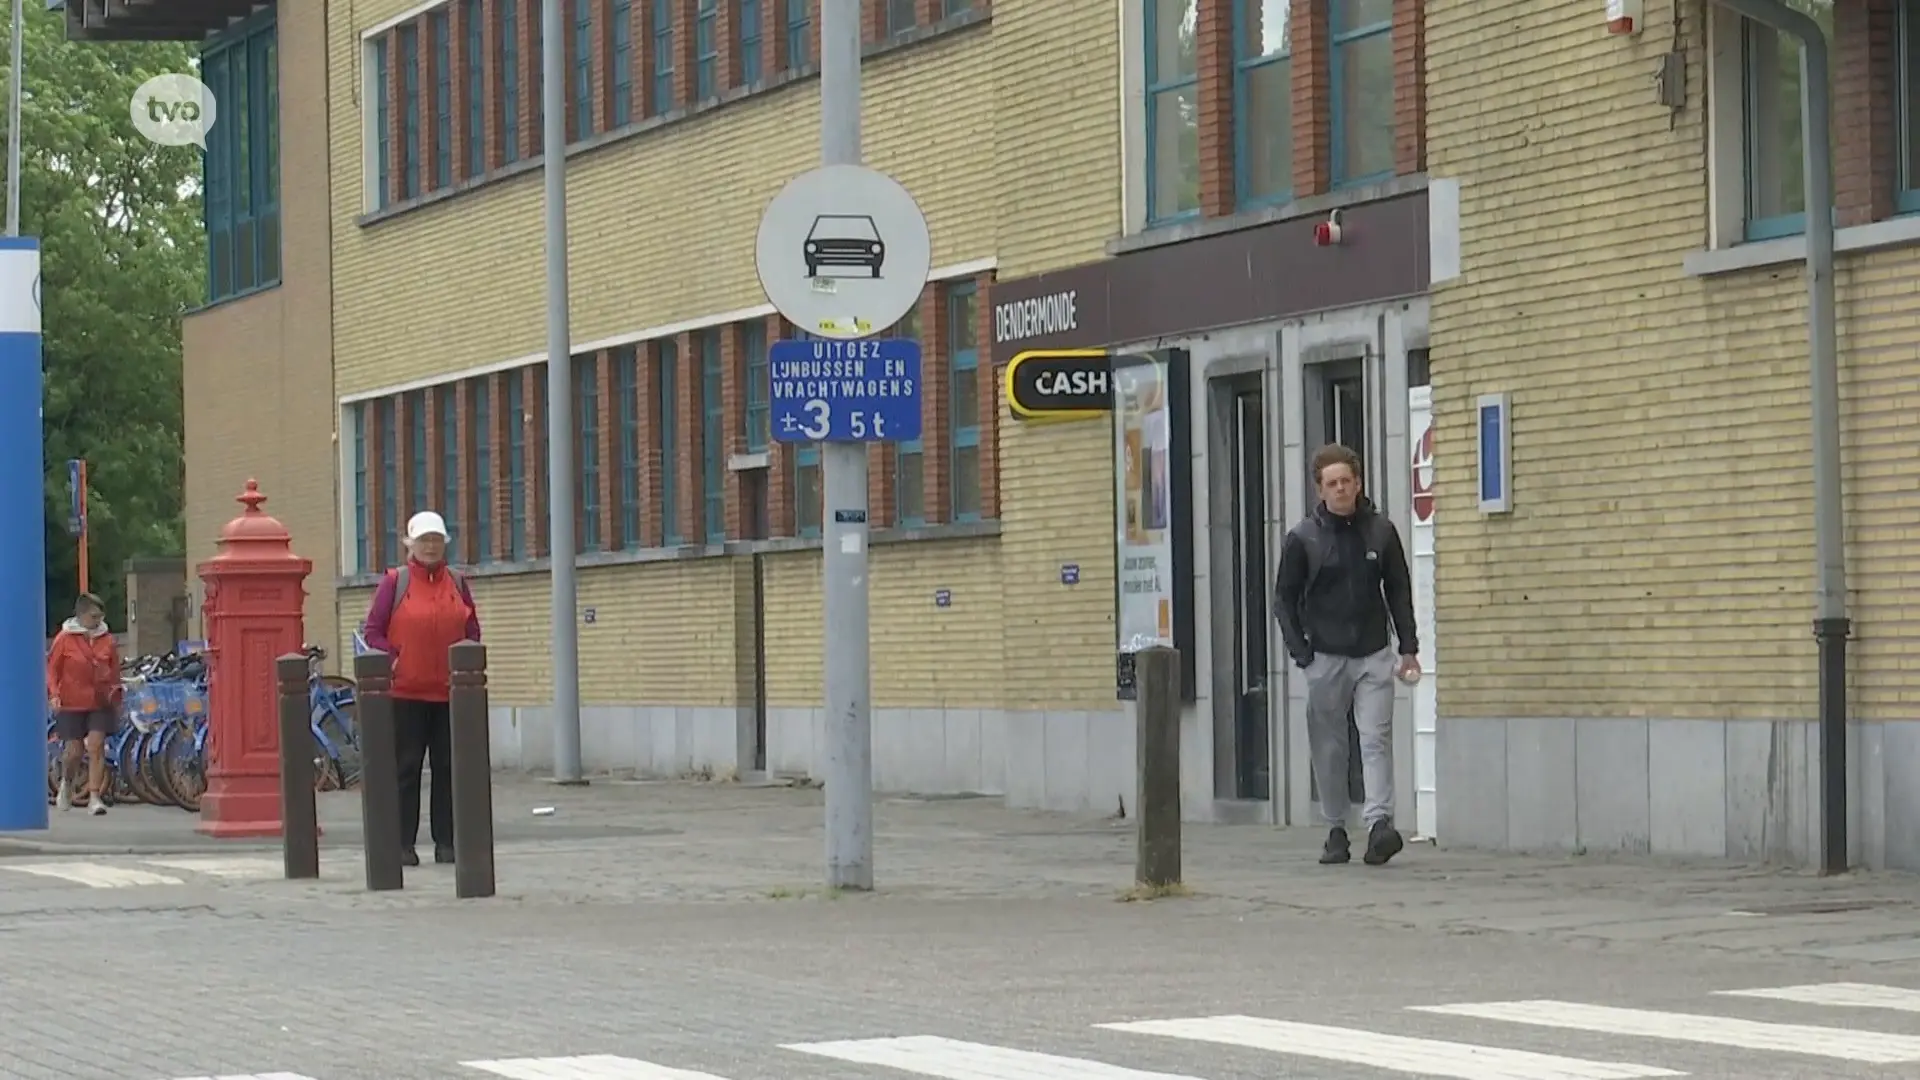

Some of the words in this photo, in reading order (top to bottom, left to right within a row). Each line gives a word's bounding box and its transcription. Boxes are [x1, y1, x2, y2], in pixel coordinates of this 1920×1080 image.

[996, 290, 1077, 342] DENDERMONDE
[813, 341, 881, 359] UITGEZ
[884, 359, 905, 377] EN
[773, 379, 913, 398] VRACHTWAGENS
[1035, 371, 1107, 395] CASH
